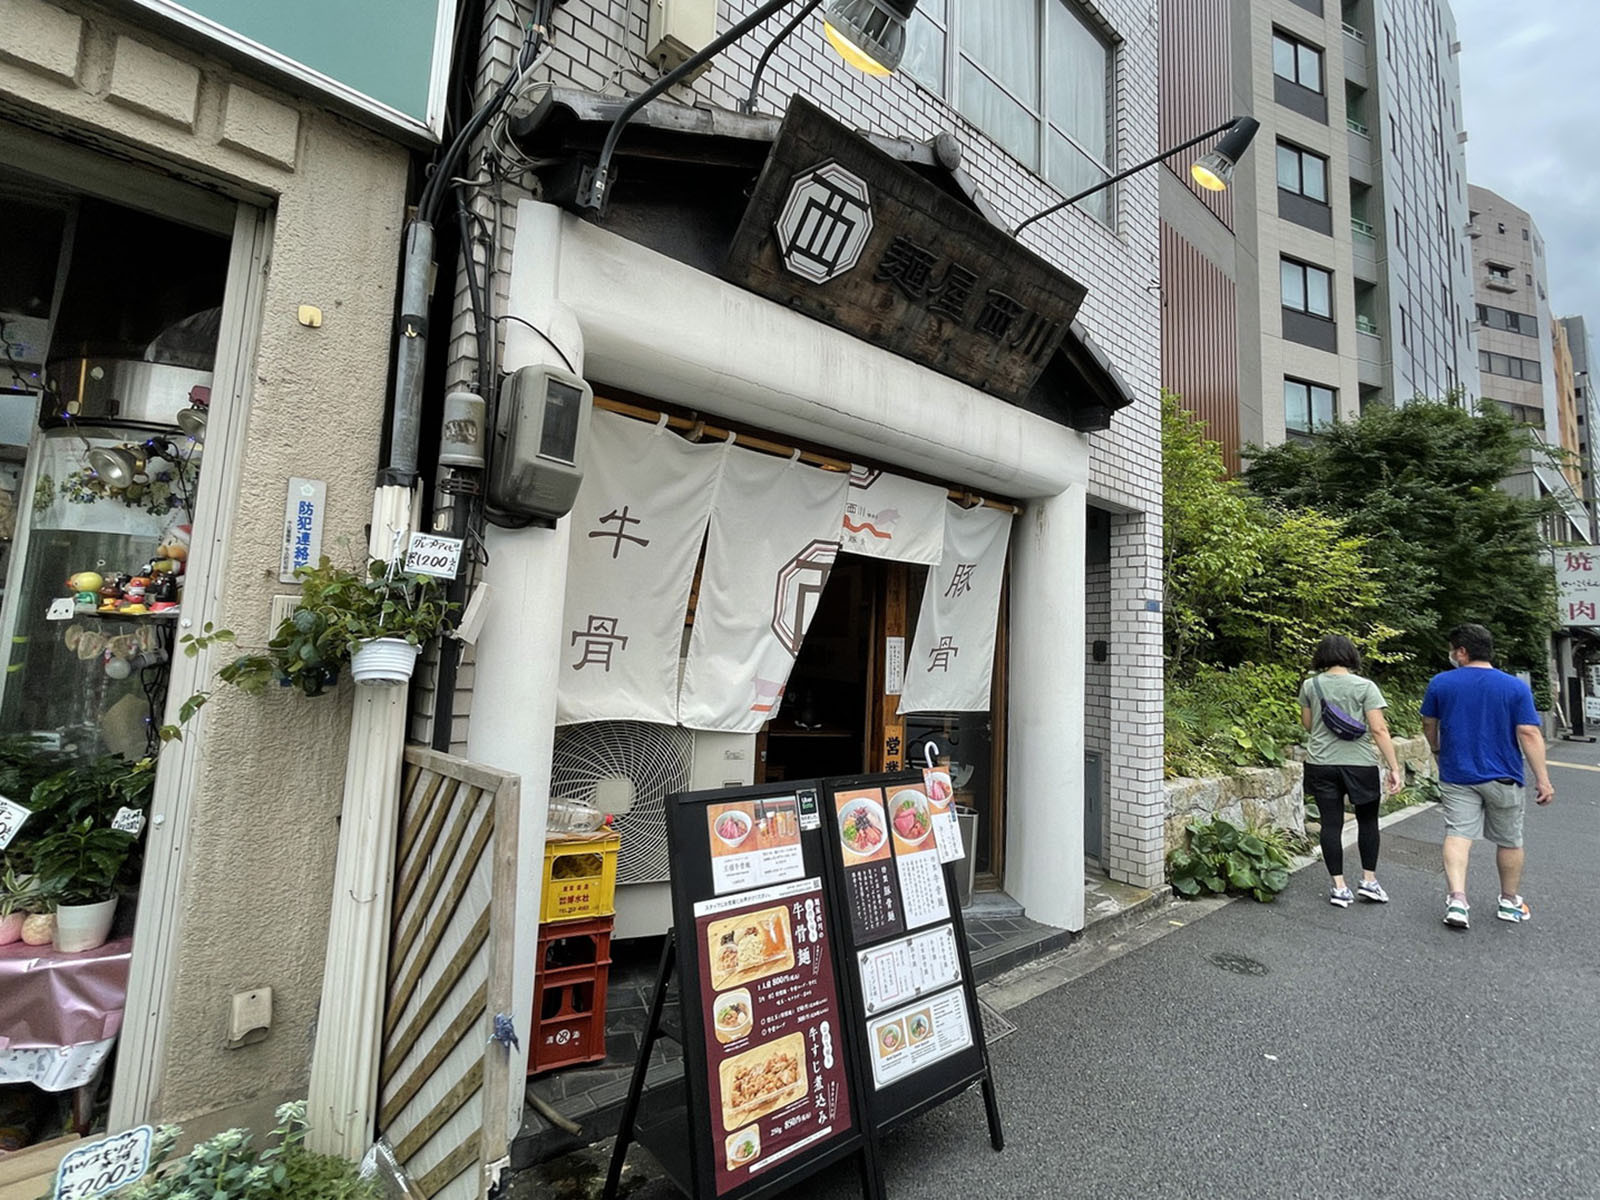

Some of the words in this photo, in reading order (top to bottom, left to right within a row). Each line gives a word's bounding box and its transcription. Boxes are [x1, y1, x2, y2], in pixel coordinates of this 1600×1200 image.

[416, 553, 449, 568] 1200
[571, 505, 650, 673] 牛骨
[926, 562, 977, 674] 豚骨
[792, 901, 812, 967] 牛骨麺
[808, 1026, 828, 1125] 牛すじ煮込み
